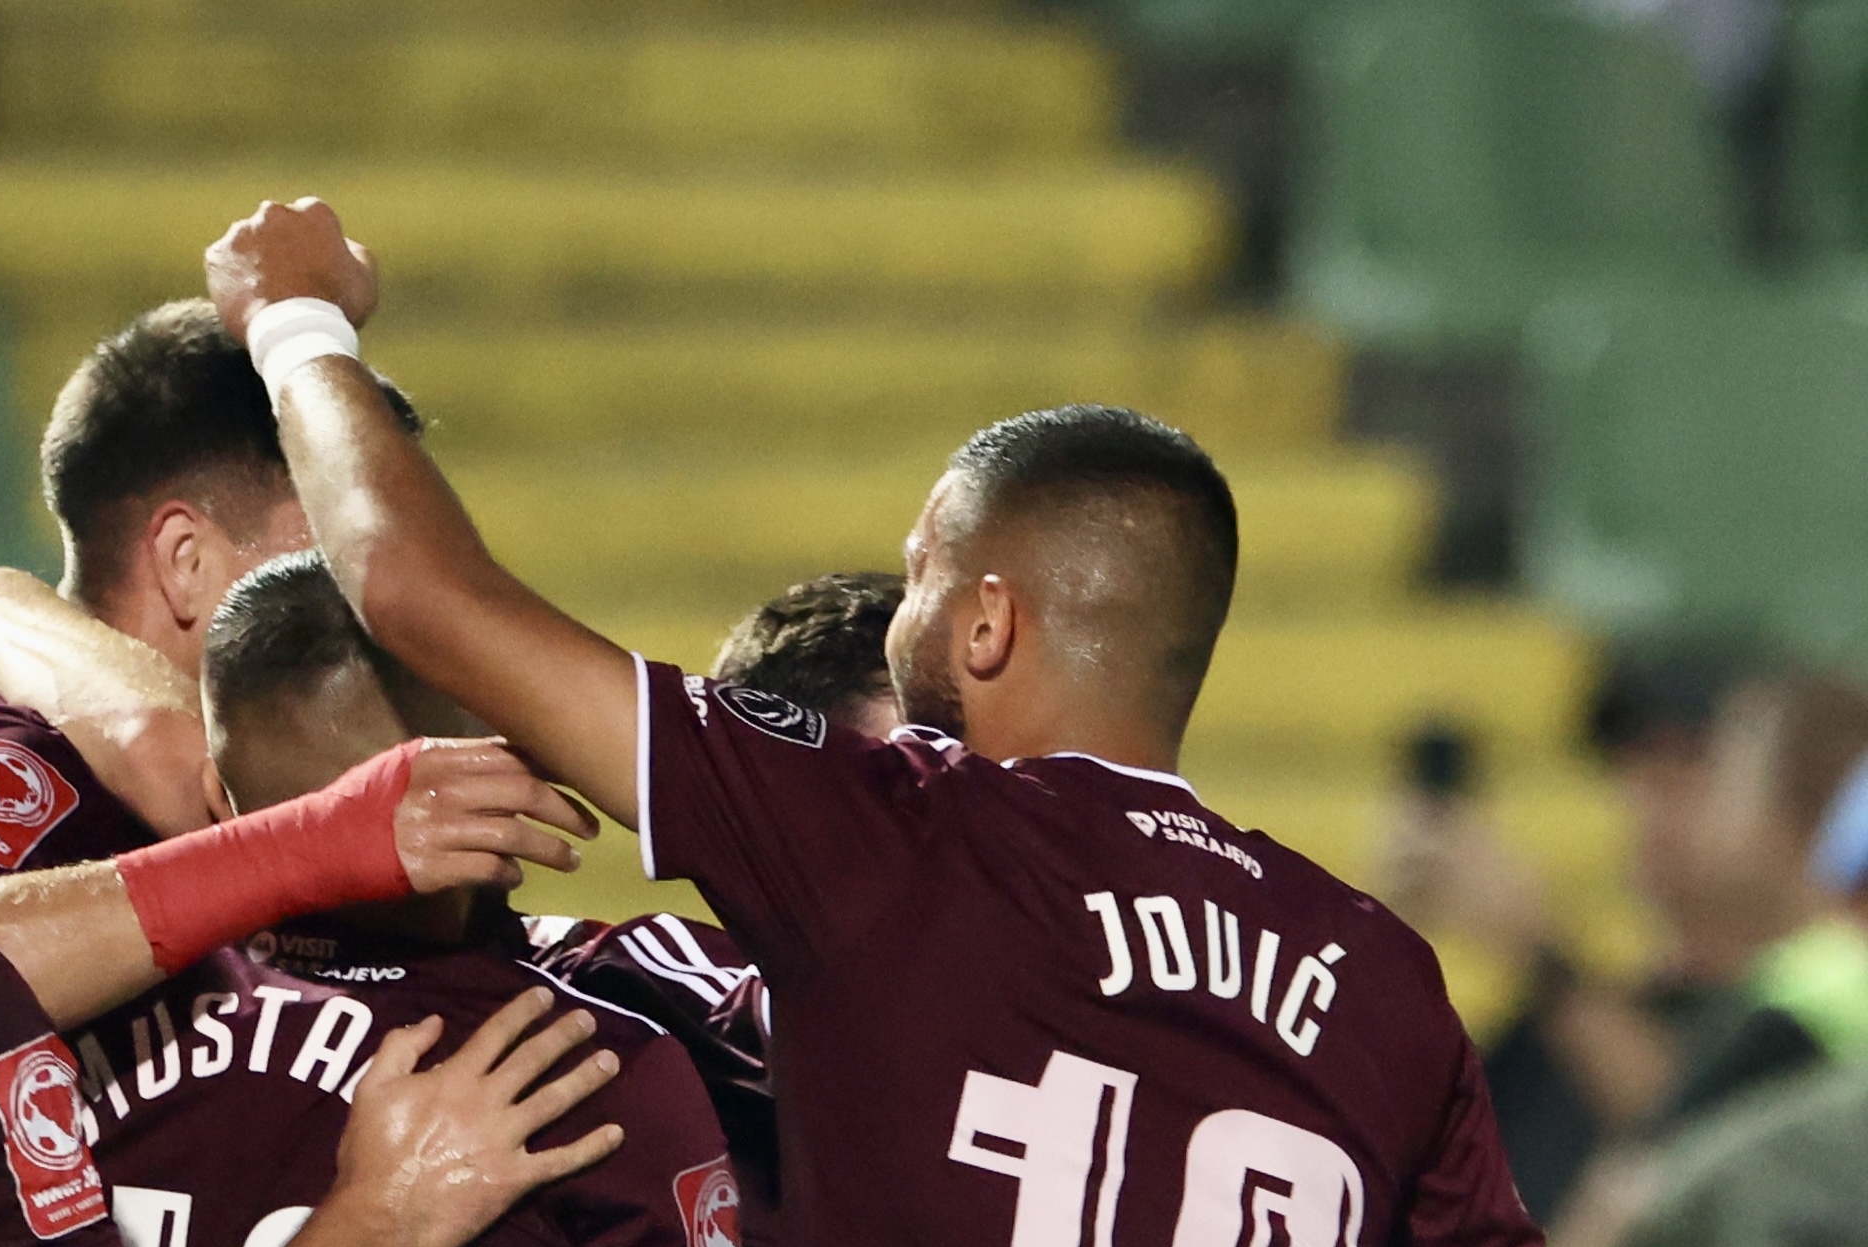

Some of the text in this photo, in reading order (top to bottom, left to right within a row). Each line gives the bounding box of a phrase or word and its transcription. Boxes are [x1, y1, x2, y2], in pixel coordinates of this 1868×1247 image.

[1151, 810, 1209, 834] VISIT
[1162, 827, 1263, 880] SARAJEVO
[1083, 891, 1347, 1057] JOVIĆ
[77, 984, 373, 1148] MUSTA
